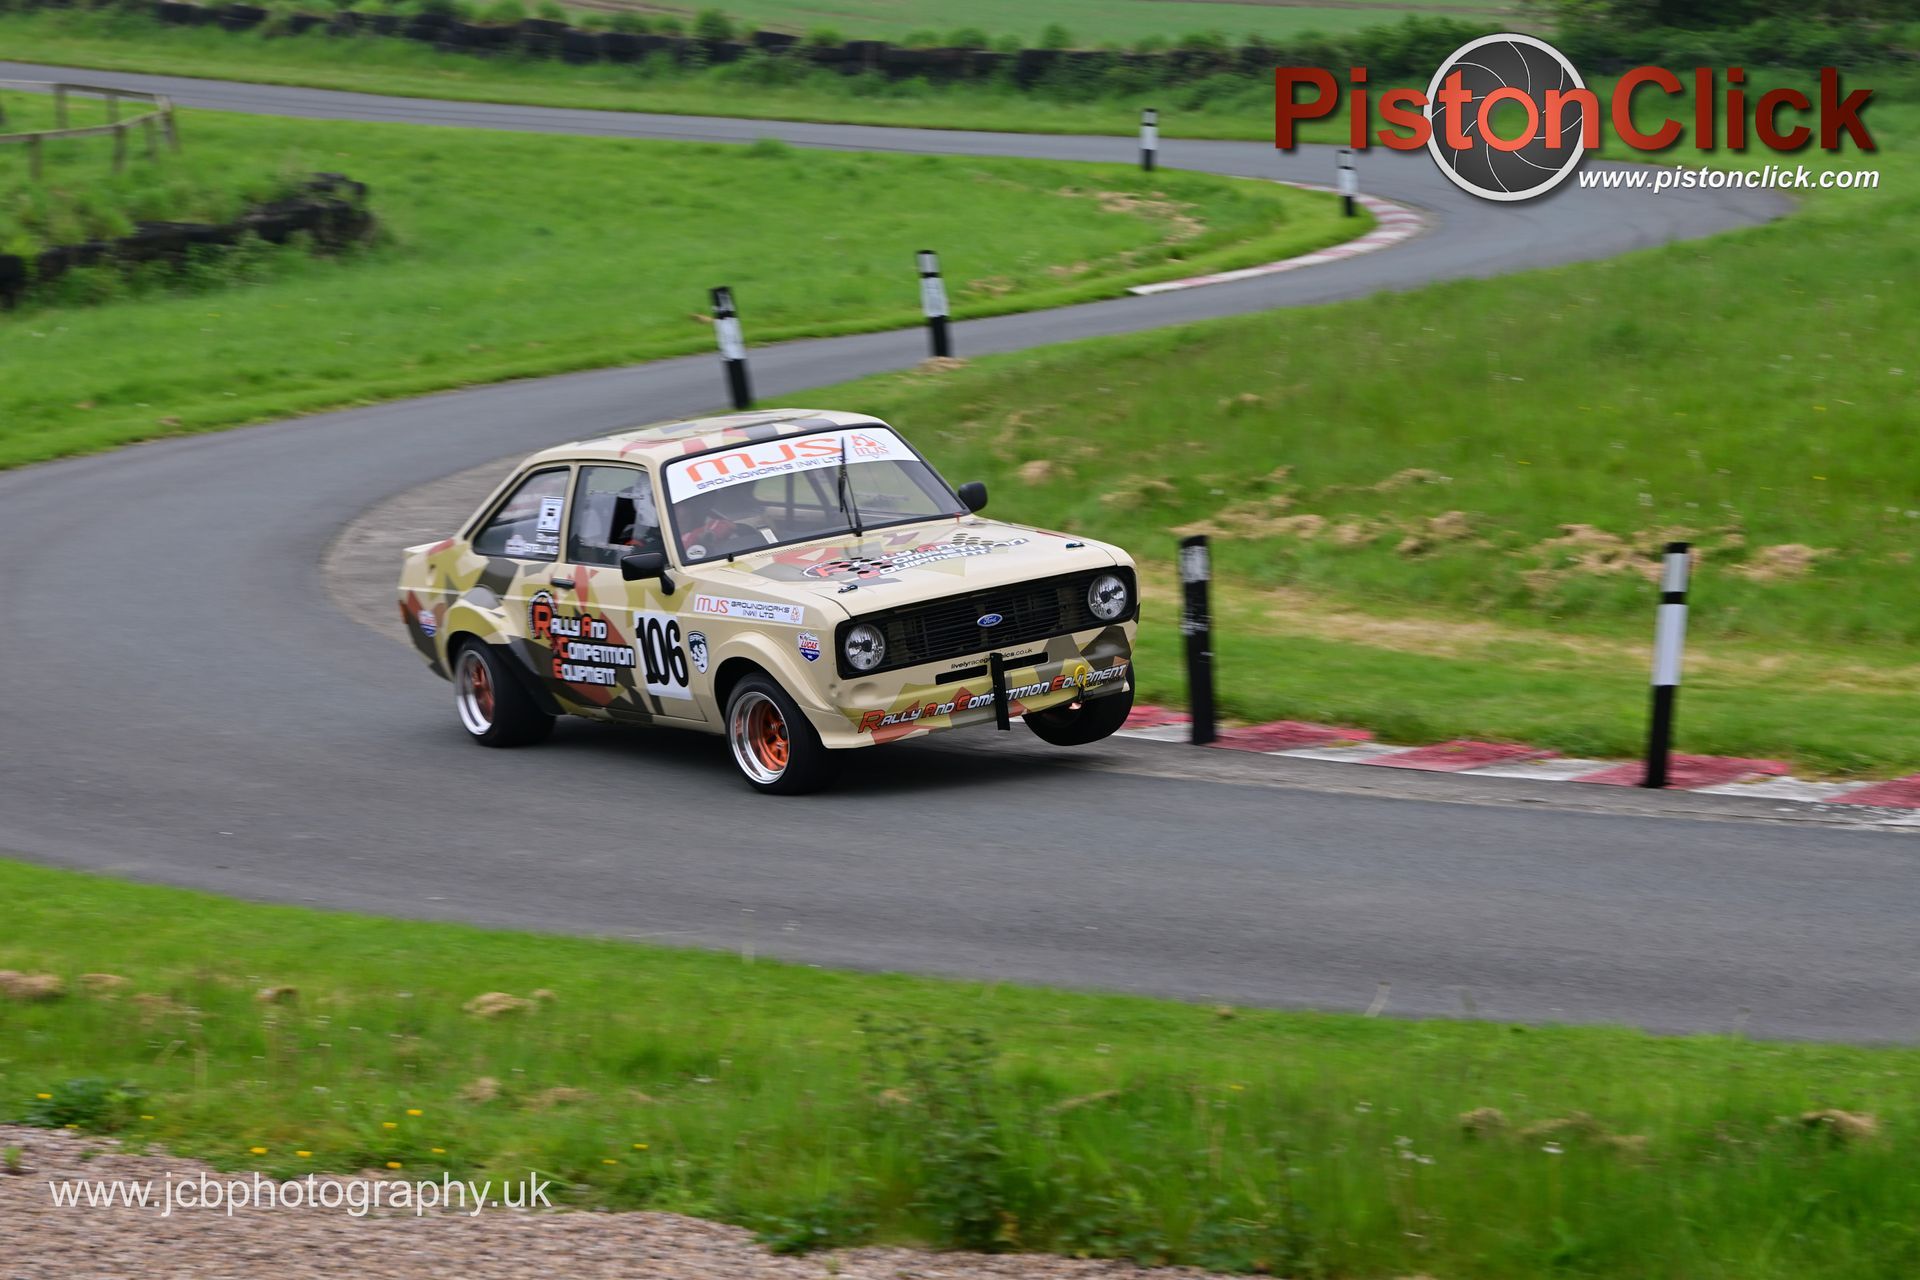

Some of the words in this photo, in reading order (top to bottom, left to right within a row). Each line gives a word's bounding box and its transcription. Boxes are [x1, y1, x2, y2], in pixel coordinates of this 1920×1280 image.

[696, 464, 793, 489] GROUNDWORKS
[697, 597, 729, 614] MJS
[731, 601, 790, 613] GROUNDWORKS
[559, 637, 635, 666] COMPETITION
[635, 616, 690, 688] 106
[800, 640, 818, 649] LUCAS
[553, 658, 615, 685] EQUIPMENT
